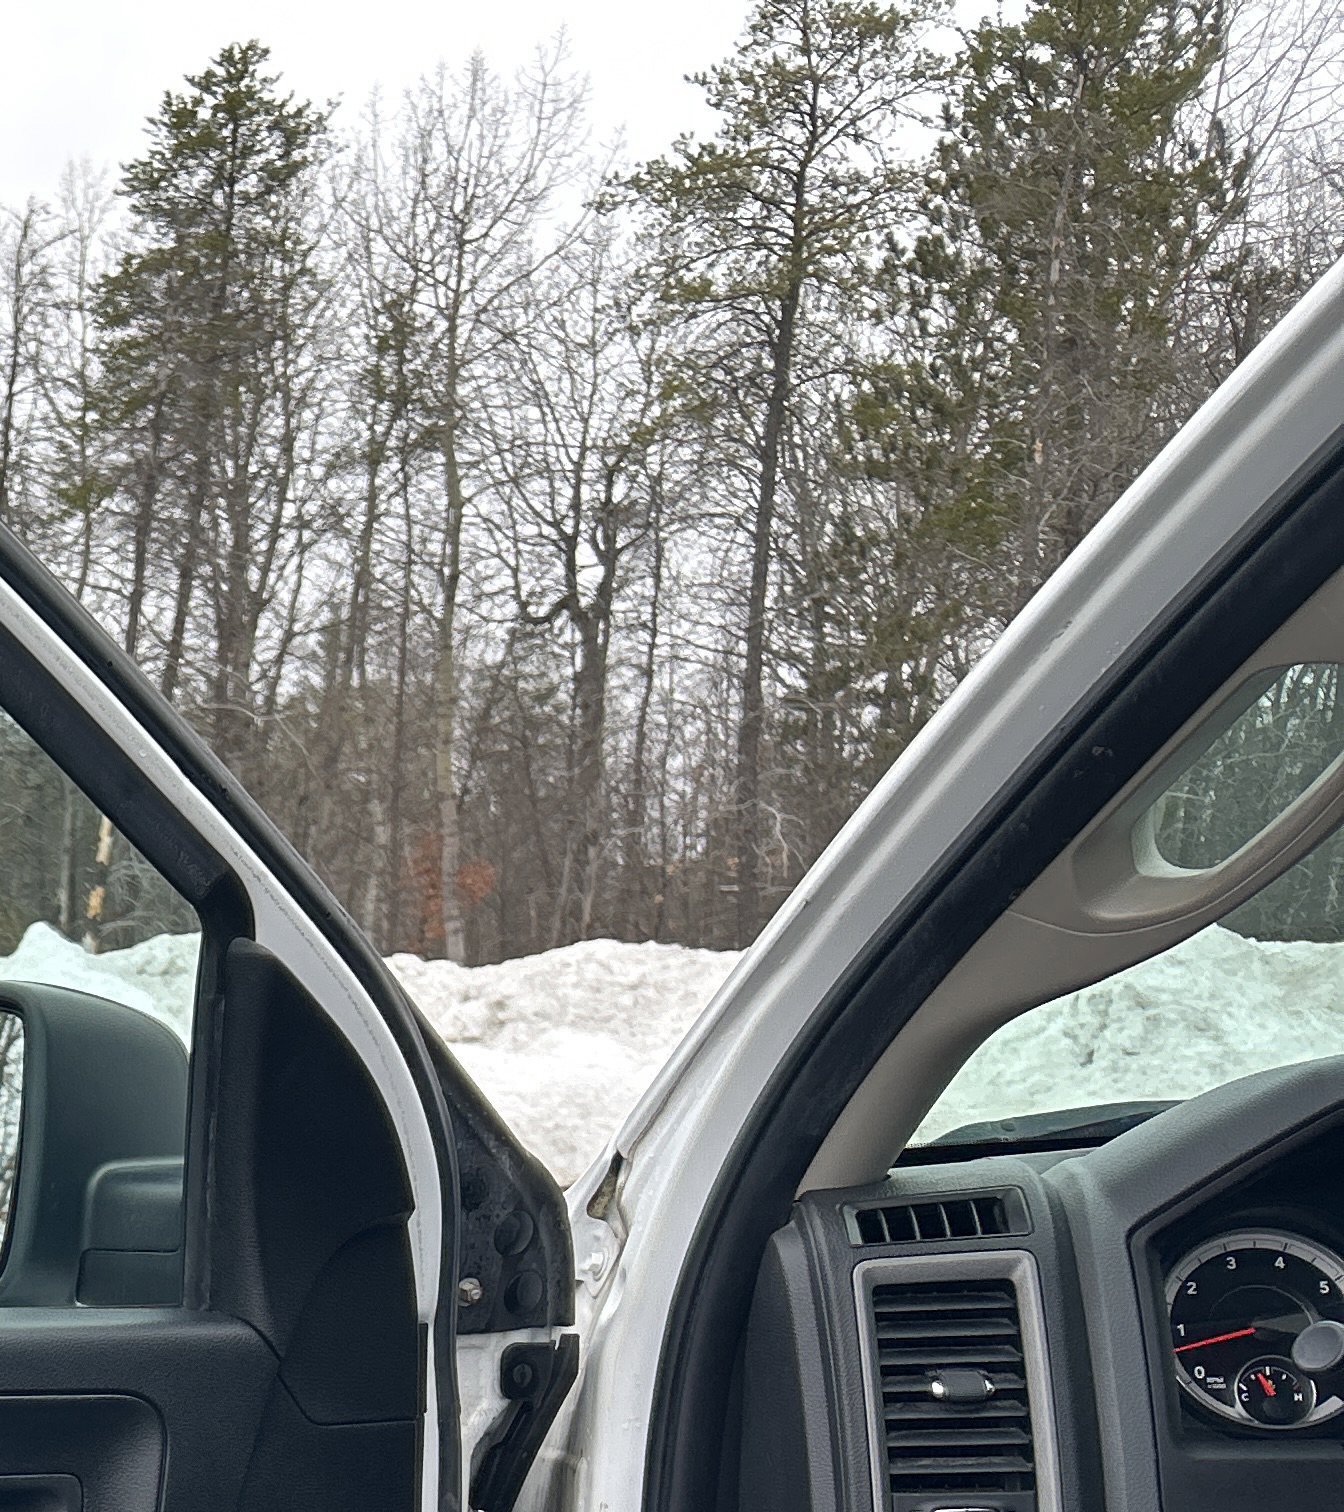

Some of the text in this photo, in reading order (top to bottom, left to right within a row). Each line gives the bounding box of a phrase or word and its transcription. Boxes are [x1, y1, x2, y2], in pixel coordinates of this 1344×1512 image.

[1225, 1256, 1237, 1270] 3
[1273, 1256, 1286, 1269] 4
[1186, 1281, 1198, 1295] 2
[1319, 1280, 1330, 1294] 5
[1177, 1323, 1186, 1337] 1
[1193, 1366, 1205, 1379] 0
[1241, 1392, 1250, 1402] C
[1293, 1392, 1303, 1402] H
